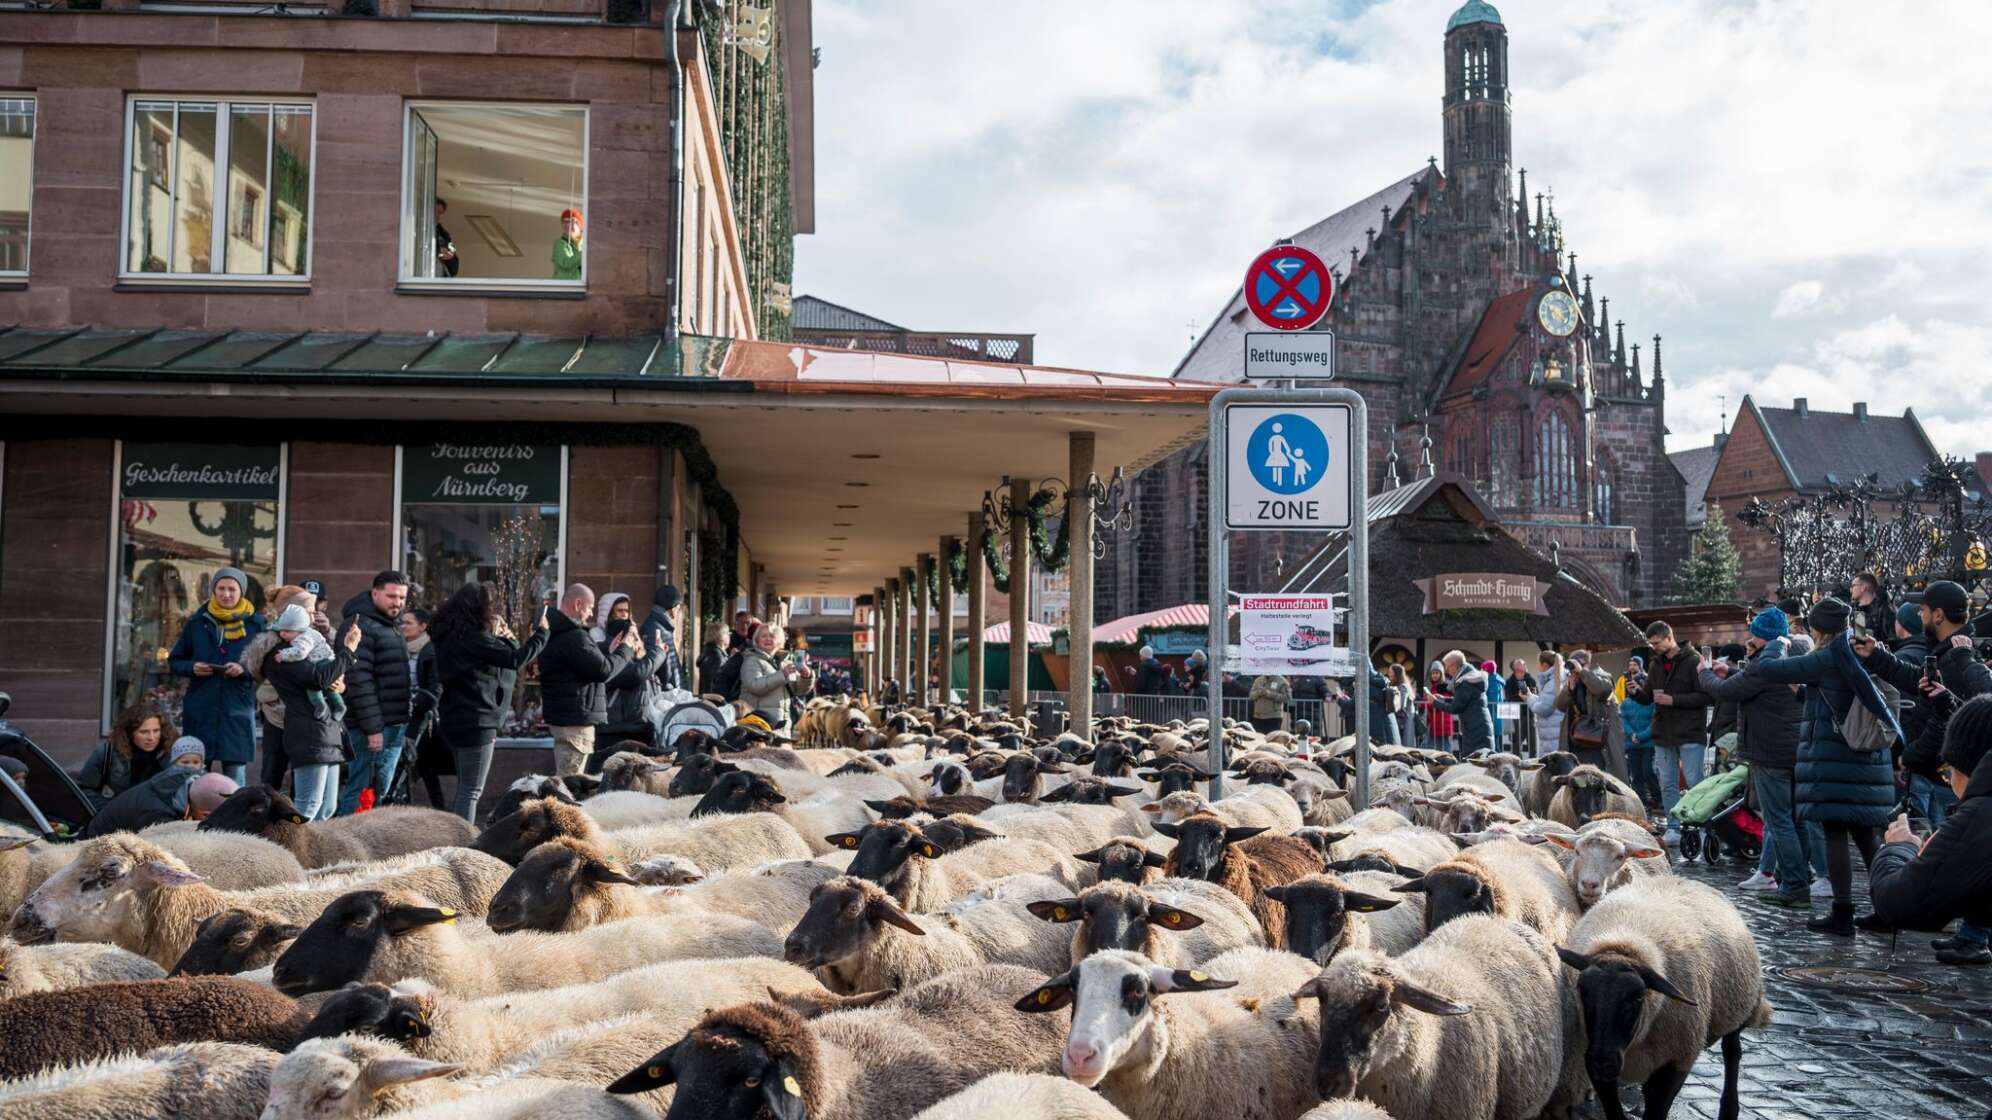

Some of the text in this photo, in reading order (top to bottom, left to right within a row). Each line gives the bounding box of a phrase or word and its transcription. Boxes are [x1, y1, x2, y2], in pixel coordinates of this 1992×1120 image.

[1250, 348, 1328, 366] Rettungsweg
[125, 462, 278, 487] Geschenkartikel
[463, 461, 500, 475] aus
[432, 475, 529, 502] Nürnberg
[1257, 500, 1319, 520] ZONE
[1246, 599, 1326, 609] Stadtrundfahrt
